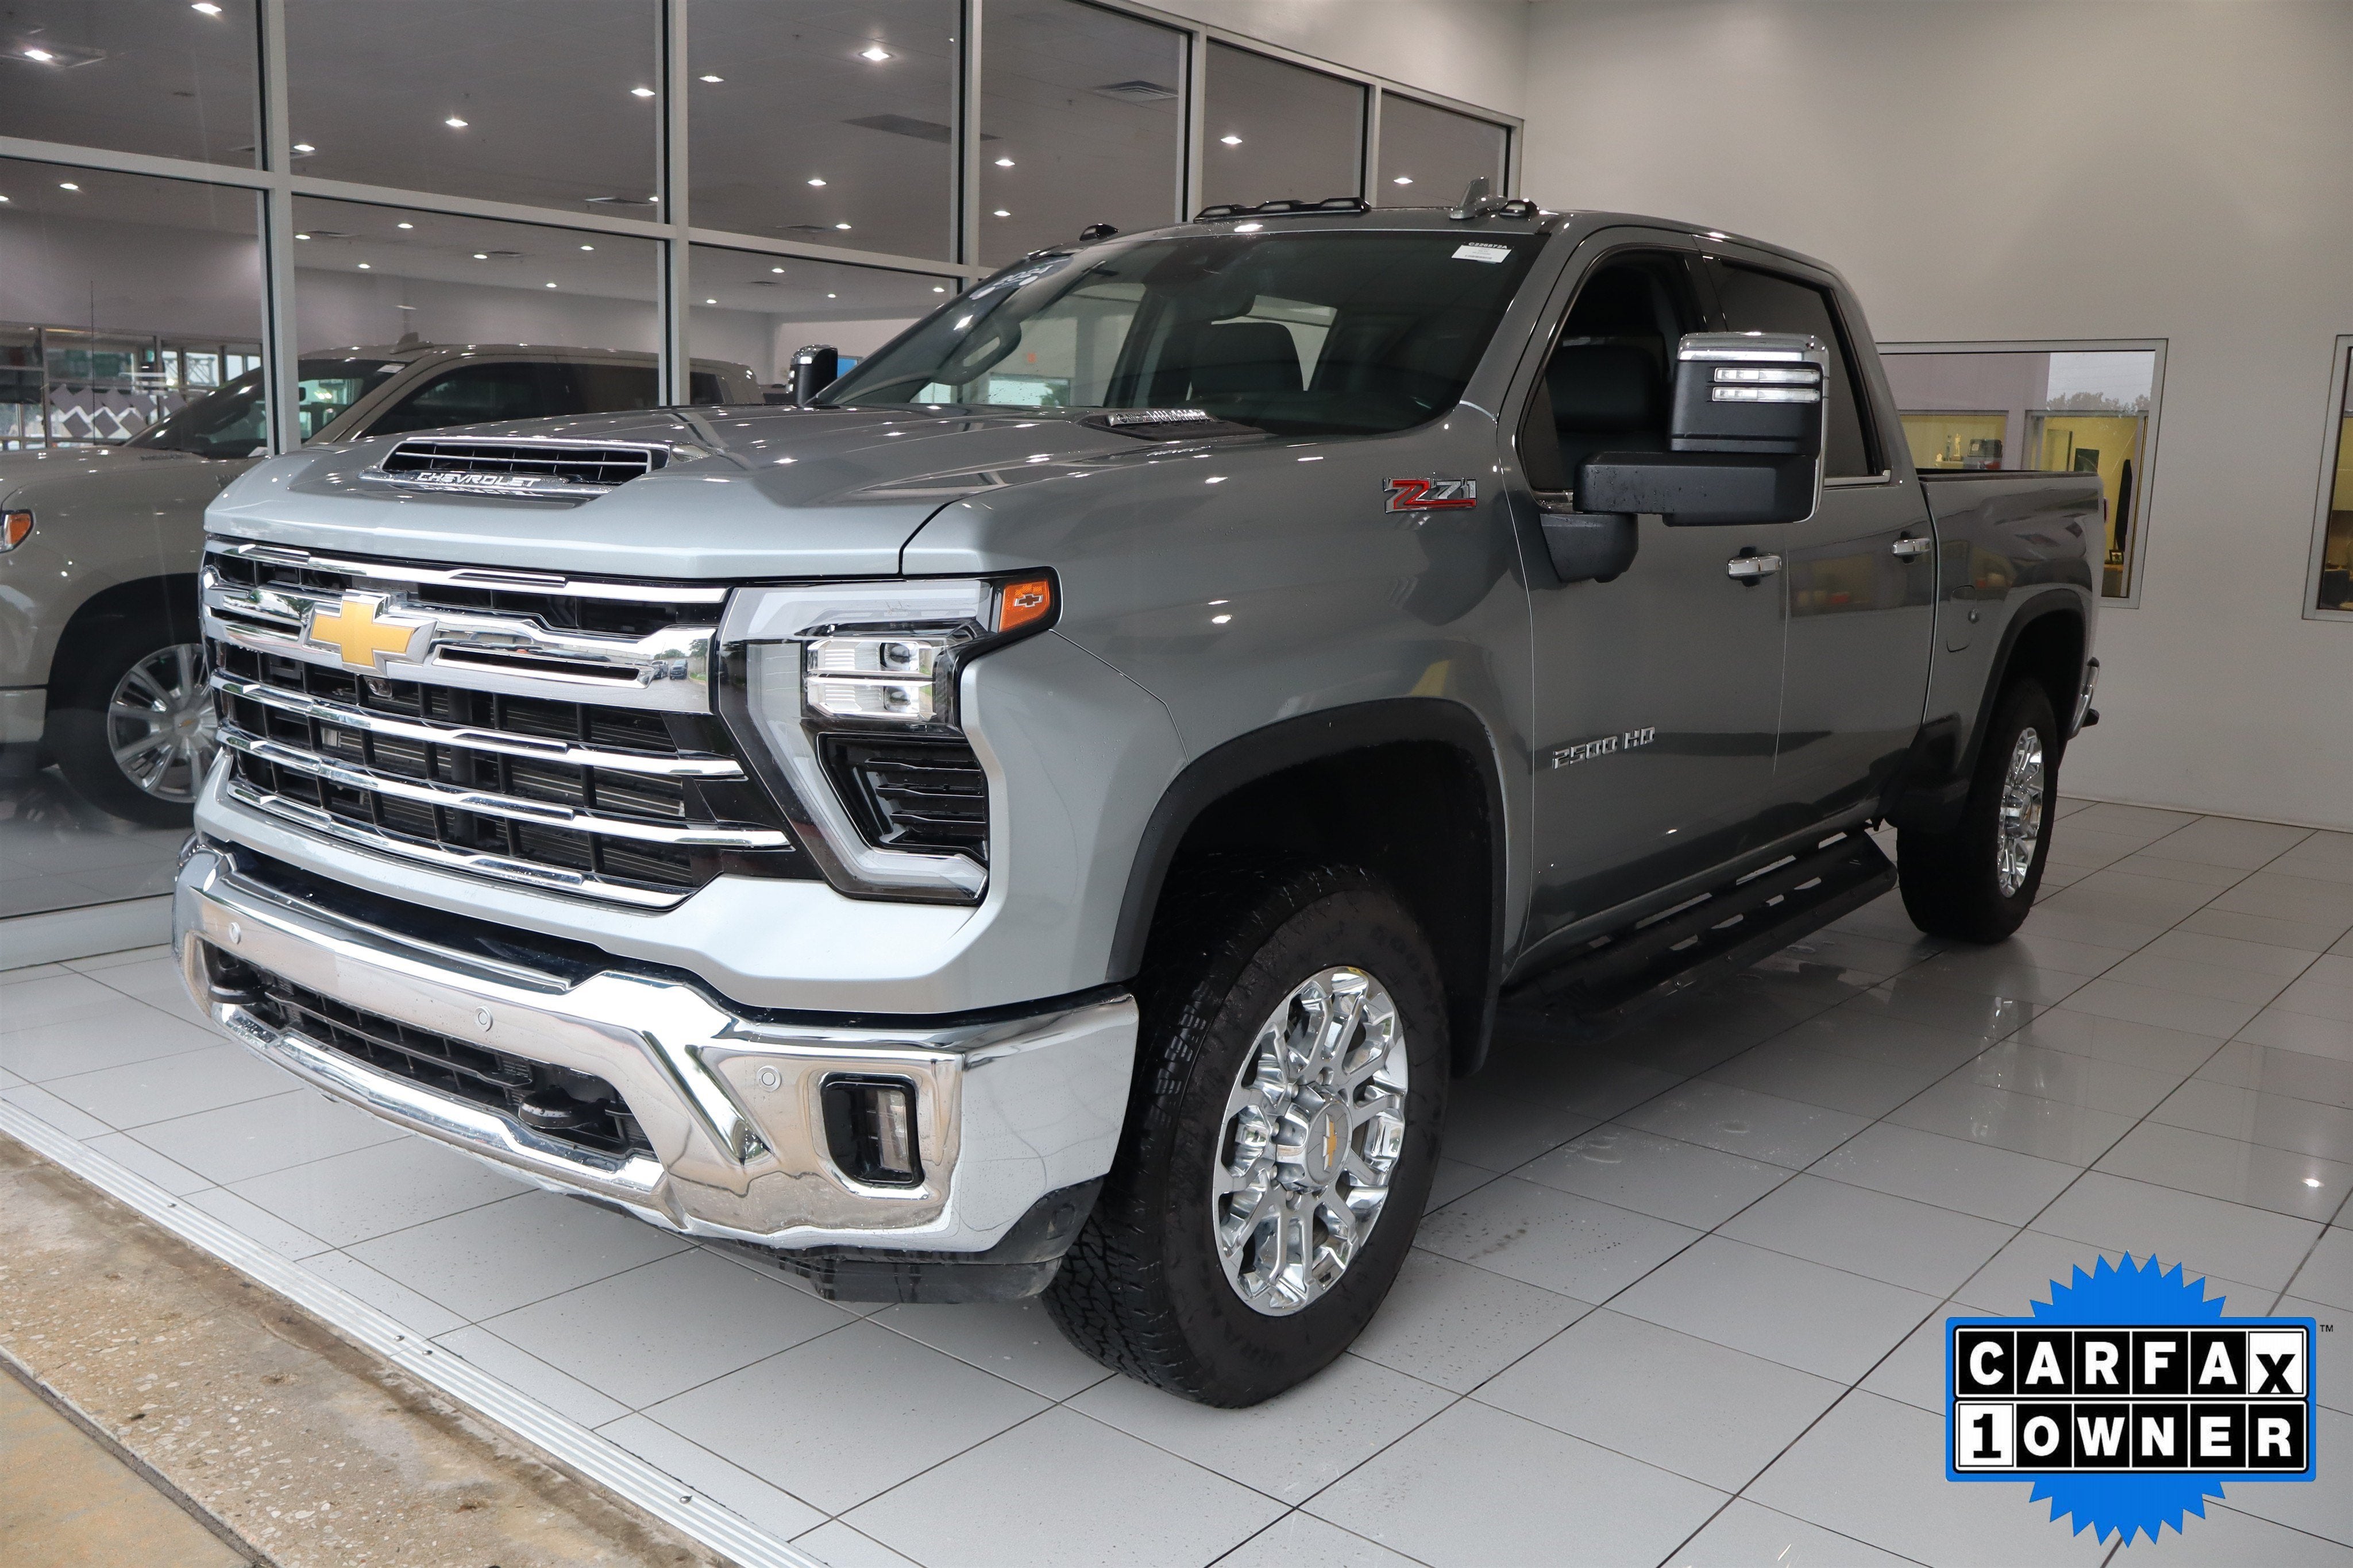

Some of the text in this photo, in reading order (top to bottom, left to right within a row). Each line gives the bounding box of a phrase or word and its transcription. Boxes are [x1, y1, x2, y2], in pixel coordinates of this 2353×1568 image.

[416, 472, 541, 487] CHEVROLET
[1383, 477, 1477, 513] Z71
[1552, 727, 1655, 769] 2500 HD
